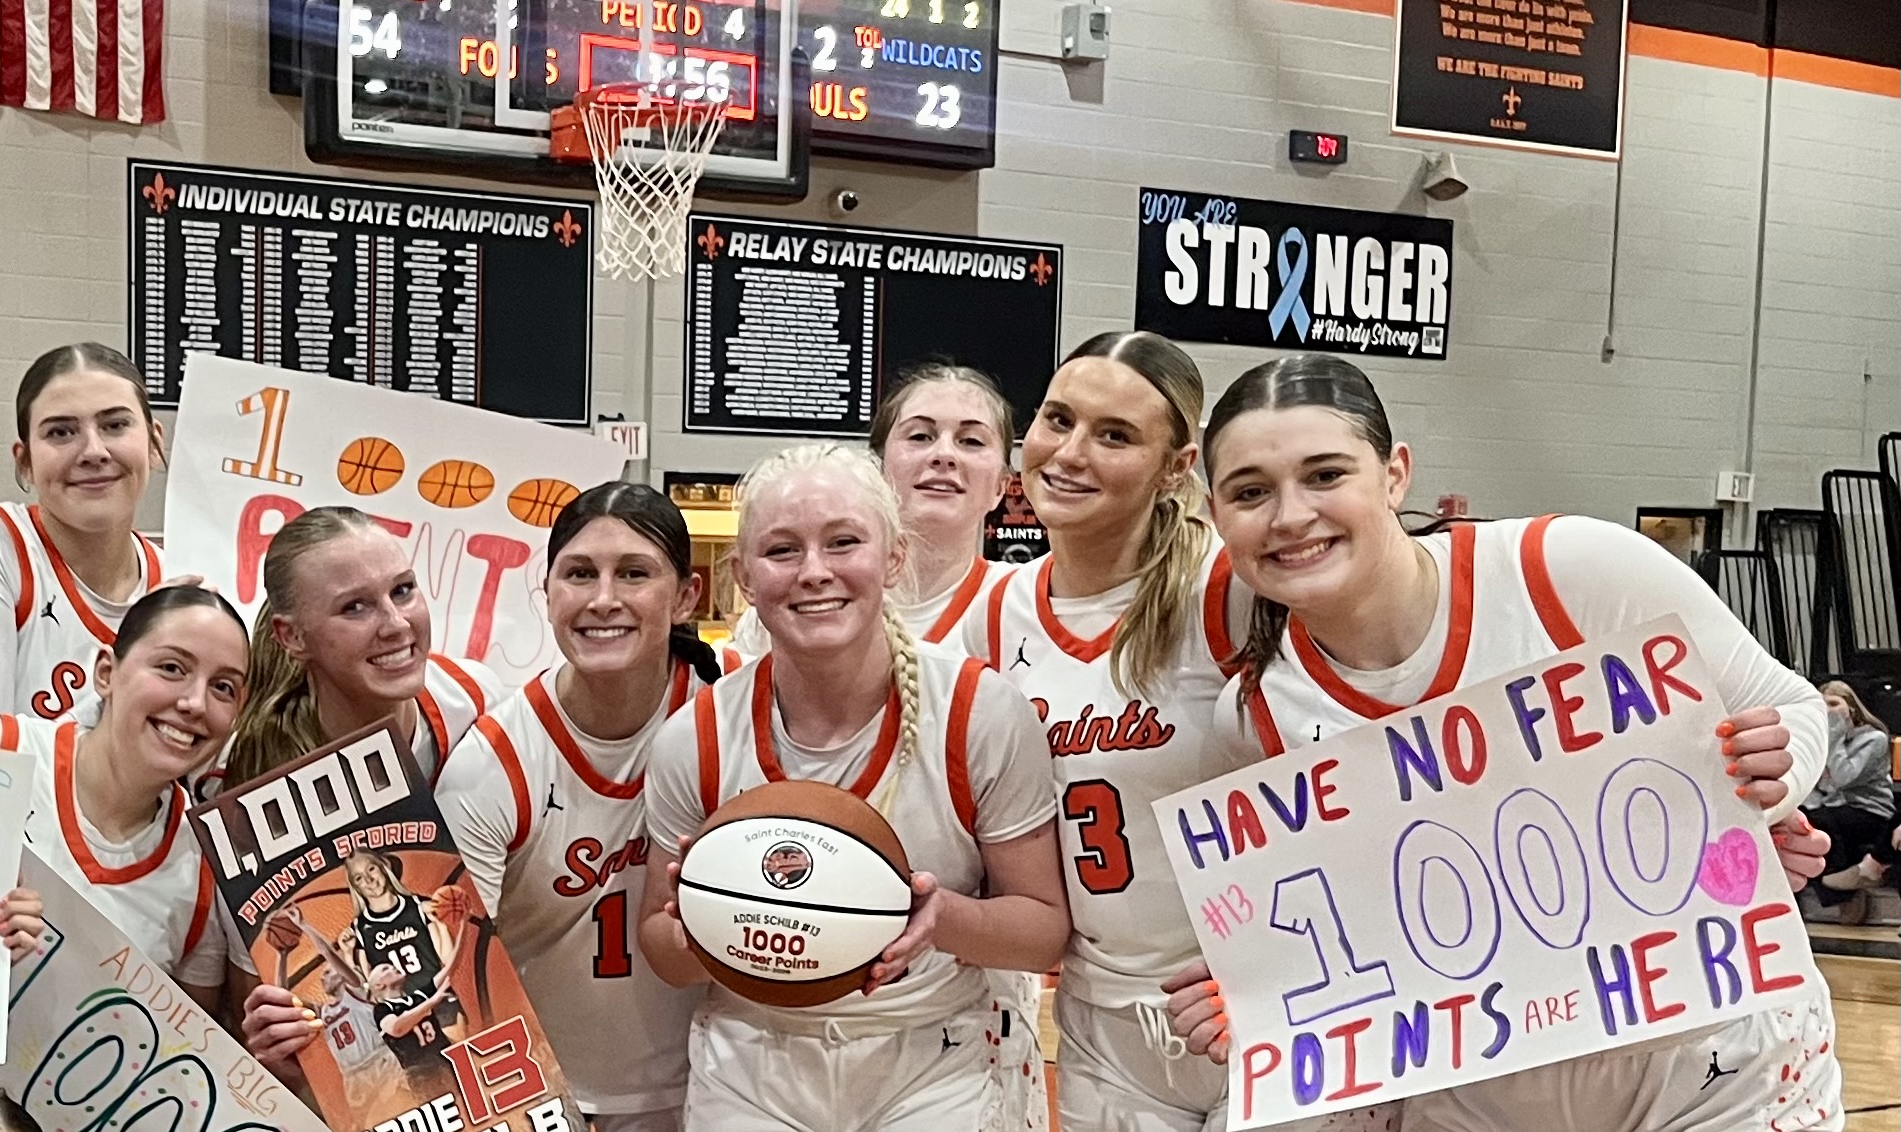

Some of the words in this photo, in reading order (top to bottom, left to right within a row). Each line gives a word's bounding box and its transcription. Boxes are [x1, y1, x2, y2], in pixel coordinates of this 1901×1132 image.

[349, 7, 402, 60] 54
[724, 8, 746, 41] 4
[854, 25, 883, 50] TOL
[962, 2, 981, 29] 2
[459, 36, 561, 85] FOS
[812, 26, 838, 71] 2
[882, 37, 983, 73] WILDCATS
[915, 81, 962, 130] 23
[178, 184, 323, 221] INDIVIDUAL
[329, 197, 400, 227] STATE
[406, 205, 550, 239] CHAMPIONS
[1142, 192, 1187, 225] YOU
[1194, 197, 1239, 230] ARE
[728, 231, 808, 263] RELAY
[811, 237, 883, 270] STATE
[887, 245, 1027, 281] CHAMPIONS
[1164, 218, 1449, 324] STRNGER
[996, 527, 1043, 540] SAINTS
[1030, 698, 1176, 758] aints
[1177, 758, 1350, 869] HAVE
[1385, 705, 1487, 802] NO
[1505, 634, 1702, 762] FEAR
[198, 728, 411, 881] 1,000
[744, 828, 773, 843] Saint
[774, 827, 816, 843] Charles
[817, 837, 840, 856] East
[1063, 778, 1134, 895] 3
[238, 847, 329, 927] POINTS
[333, 821, 438, 861] SCORED
[1269, 757, 1709, 1027] 1000
[733, 913, 761, 926] ADDIE
[763, 913, 800, 931] SCHILB
[1201, 883, 1255, 941] #13
[374, 926, 418, 950] Saints
[387, 944, 422, 976] 13
[726, 944, 773, 967] Career
[774, 956, 820, 971] Points
[742, 926, 806, 957] 1000
[98, 945, 218, 1054] ADDIE'S
[226, 1055, 282, 1118] BIG
[1242, 983, 1511, 1121] POINTS
[1524, 989, 1581, 1036] ARE
[1586, 902, 1806, 1039] HERE
[441, 1014, 549, 1126] 13
